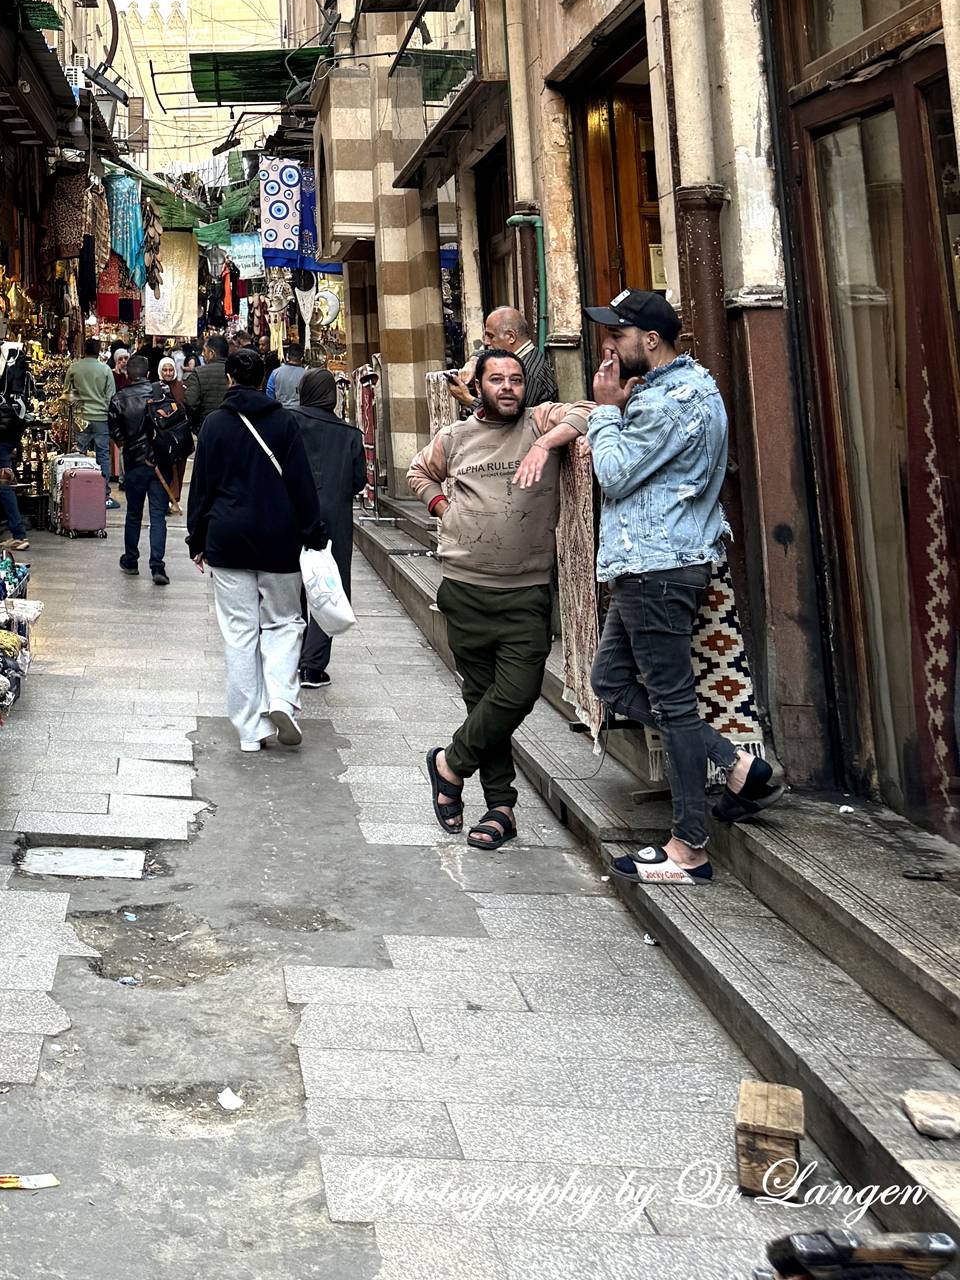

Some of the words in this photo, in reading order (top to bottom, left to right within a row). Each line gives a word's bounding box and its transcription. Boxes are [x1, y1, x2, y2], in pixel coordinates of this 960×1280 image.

[456, 464, 485, 476] ALPHA
[487, 459, 520, 471] RULES
[664, 870, 685, 880] Camp
